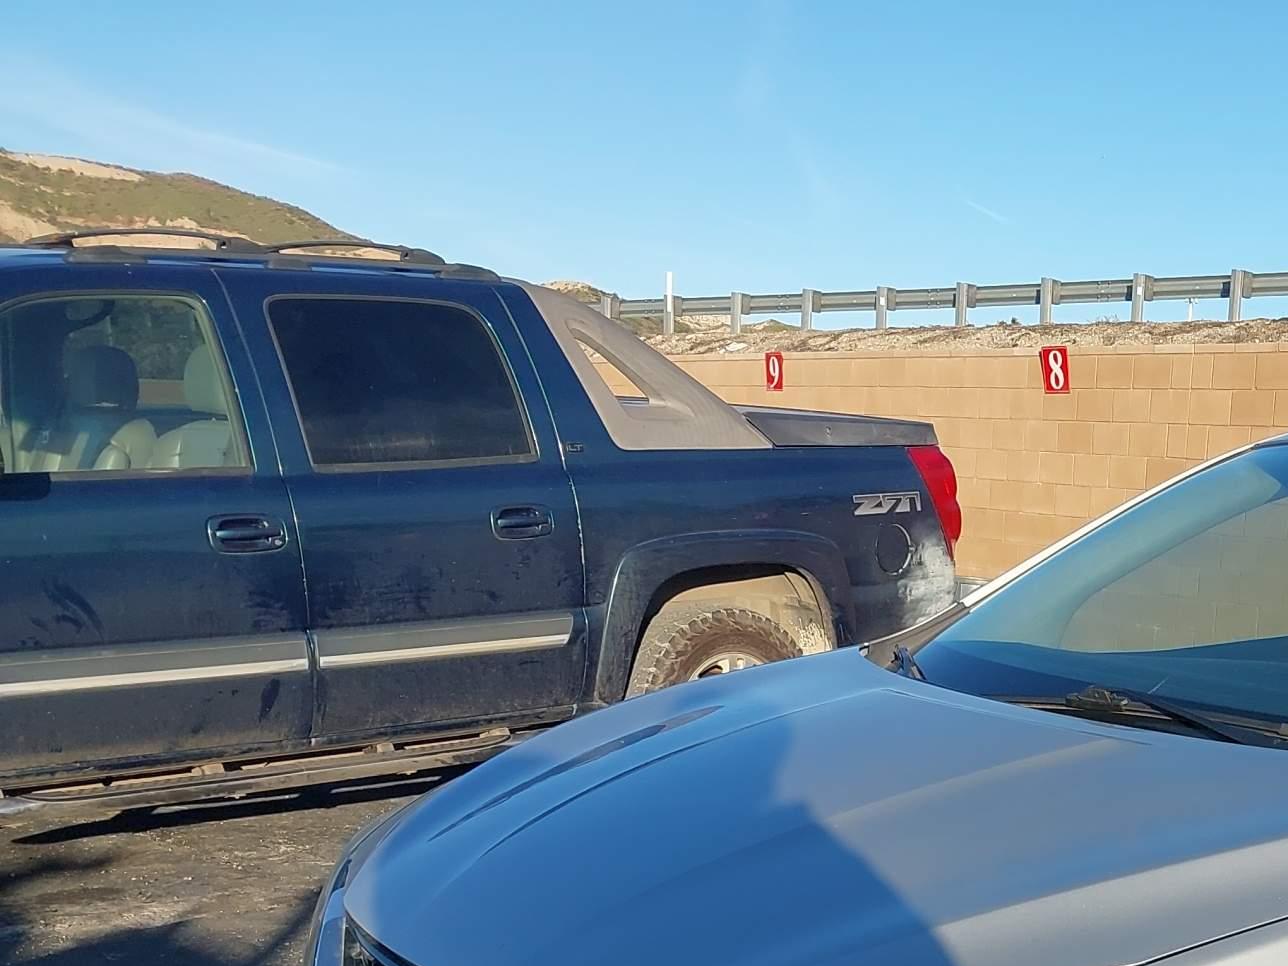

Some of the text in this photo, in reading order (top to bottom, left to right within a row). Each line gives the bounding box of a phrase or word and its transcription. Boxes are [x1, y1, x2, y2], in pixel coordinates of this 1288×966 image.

[767, 357, 781, 388] 9
[1048, 351, 1065, 390] 8
[852, 491, 922, 516] Z71
